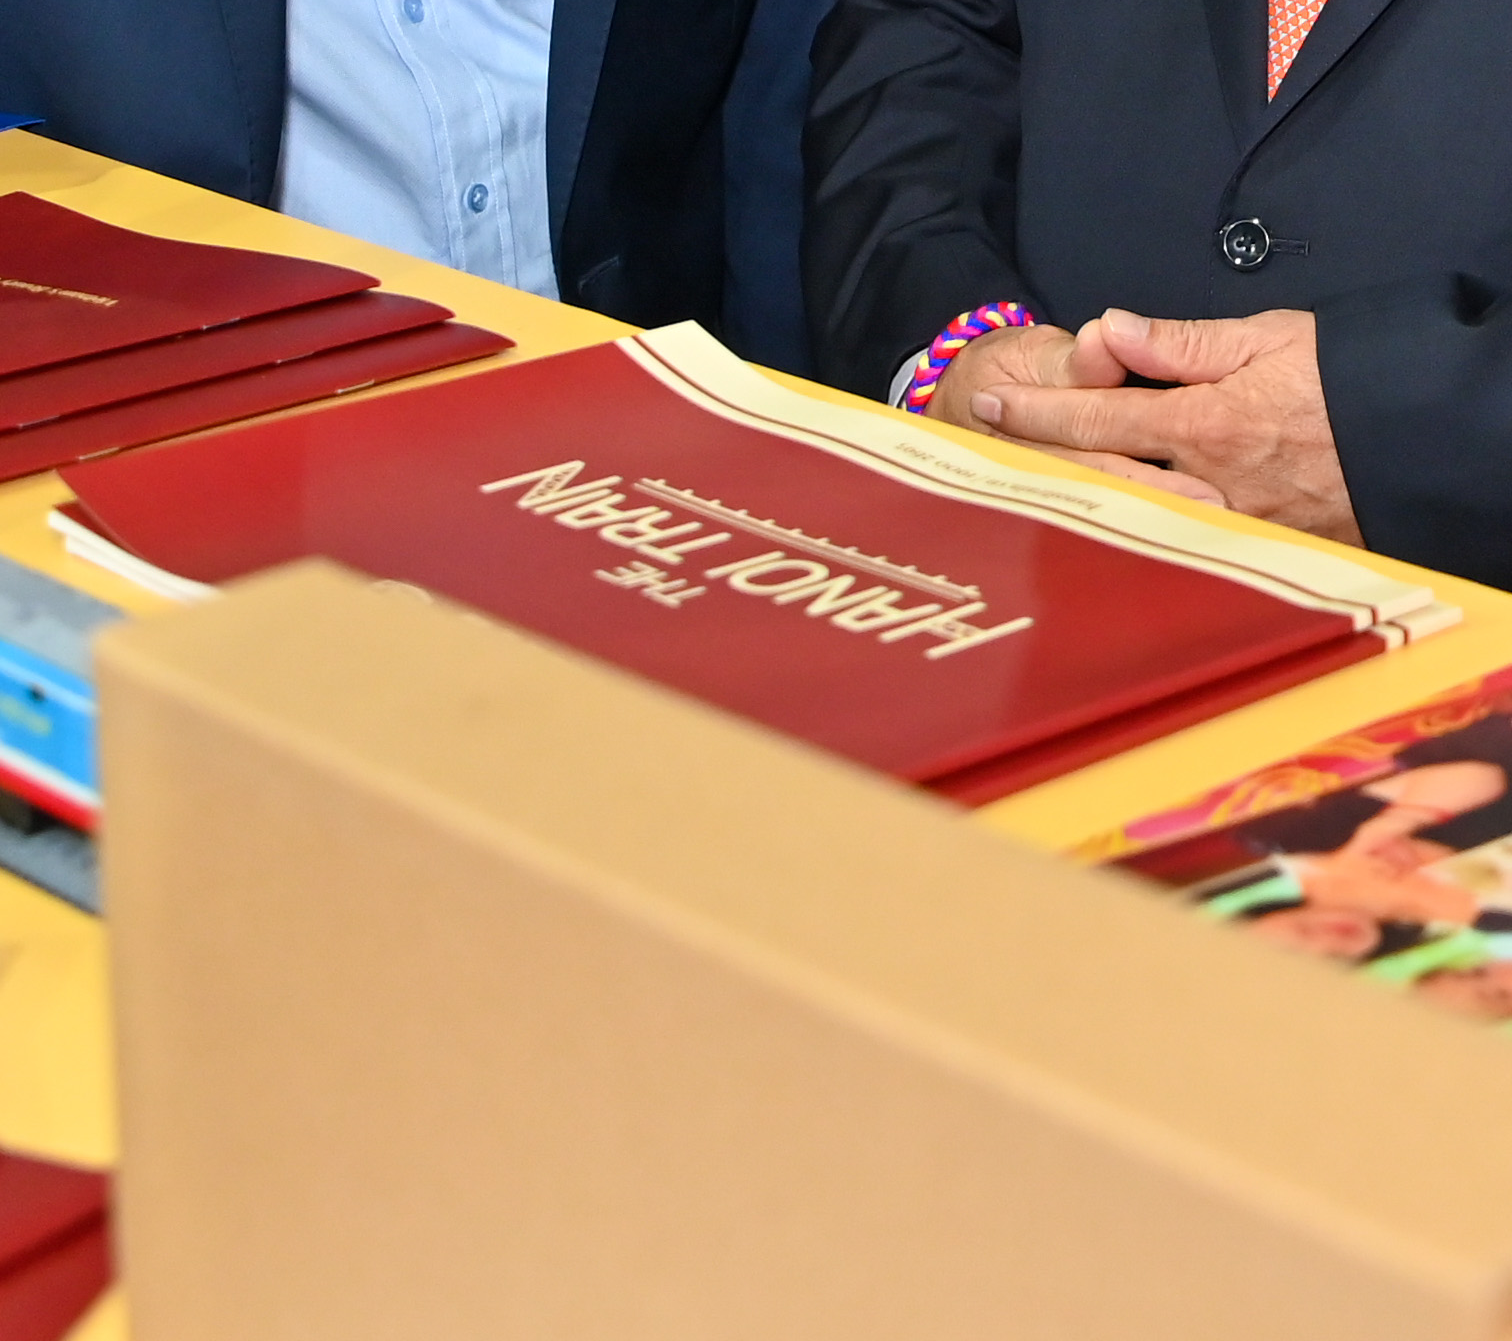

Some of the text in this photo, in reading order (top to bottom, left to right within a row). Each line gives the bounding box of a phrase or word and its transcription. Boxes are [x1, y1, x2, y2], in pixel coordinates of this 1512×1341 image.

[479, 459, 1035, 660] HANOI TRAIN
[593, 560, 707, 608] THE
